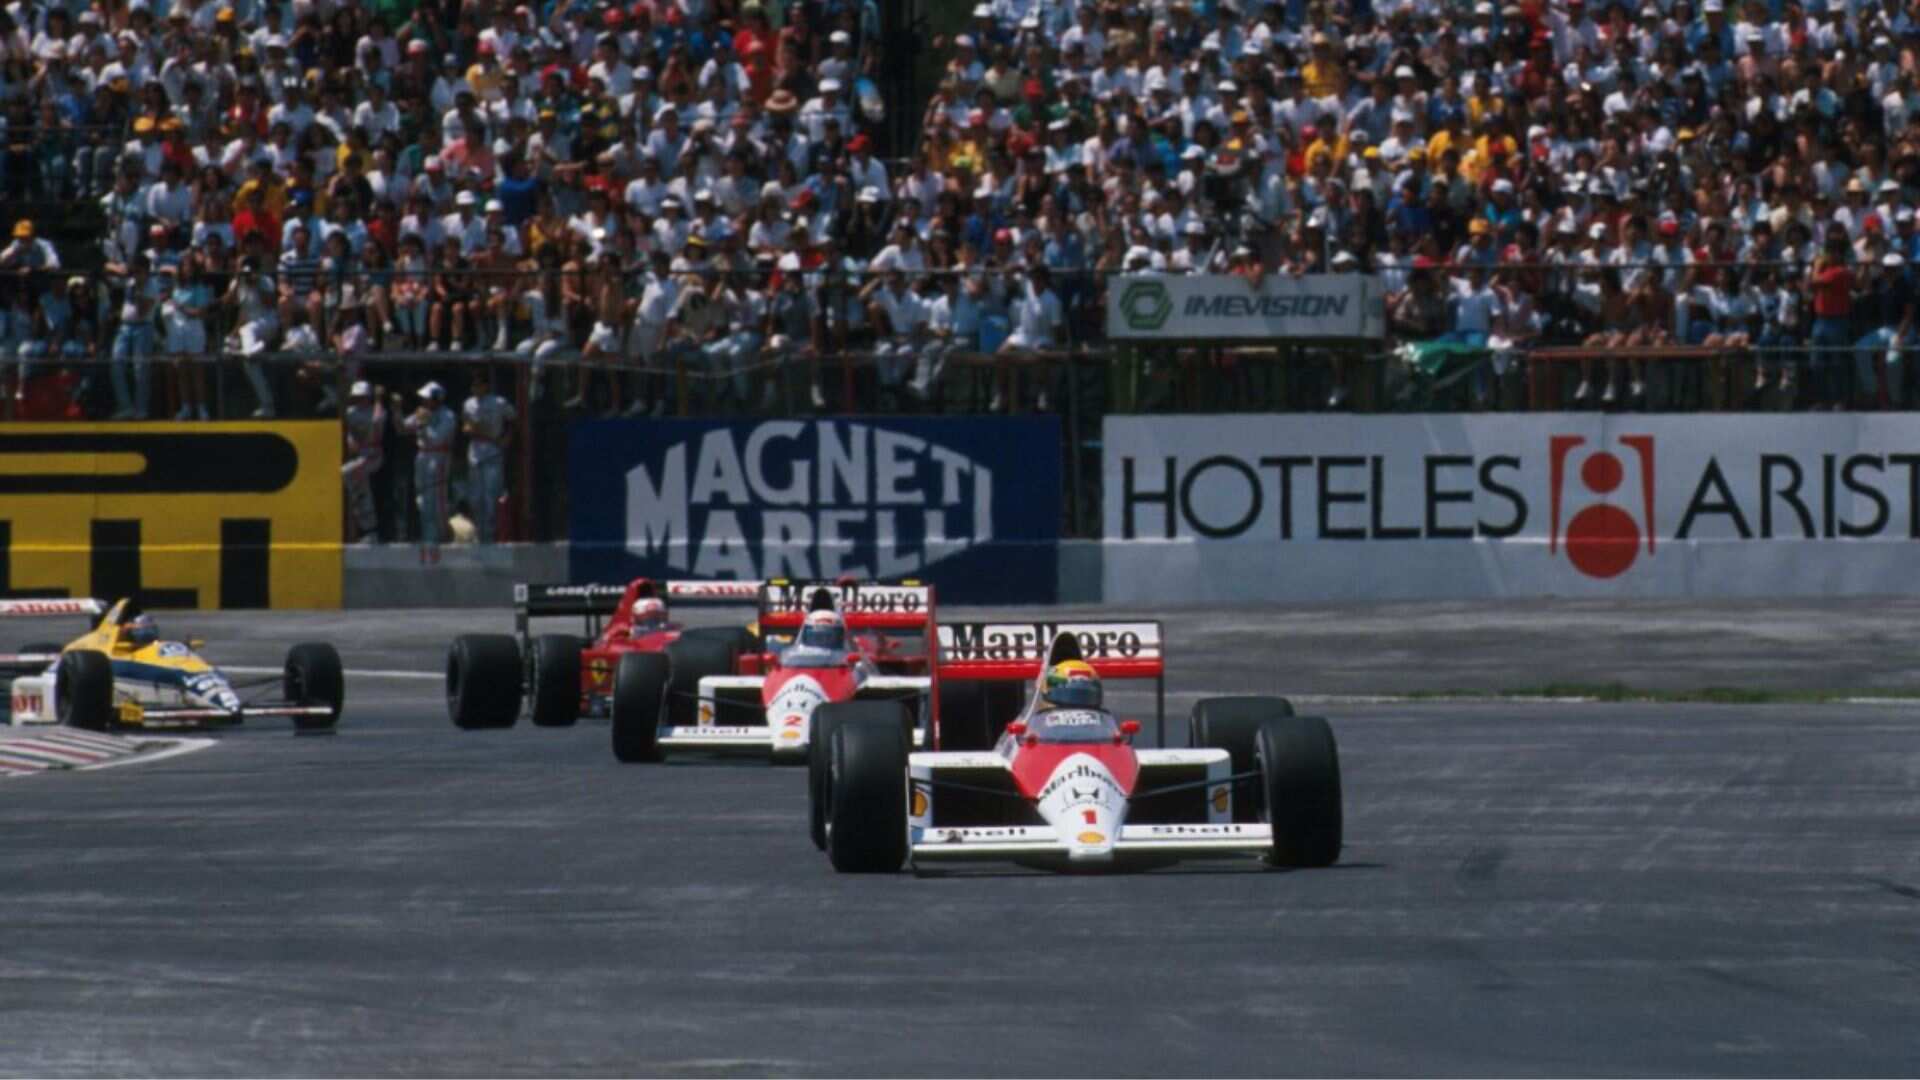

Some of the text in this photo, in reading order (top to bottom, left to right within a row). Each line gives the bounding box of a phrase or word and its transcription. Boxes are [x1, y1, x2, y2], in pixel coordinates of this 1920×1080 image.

[1184, 294, 1348, 317] IMEVISION
[626, 420, 992, 530] MAGNETI
[1122, 454, 1920, 539] HOTELES ARIST
[626, 498, 992, 580] MARELLI
[1082, 810, 1097, 824] 1
